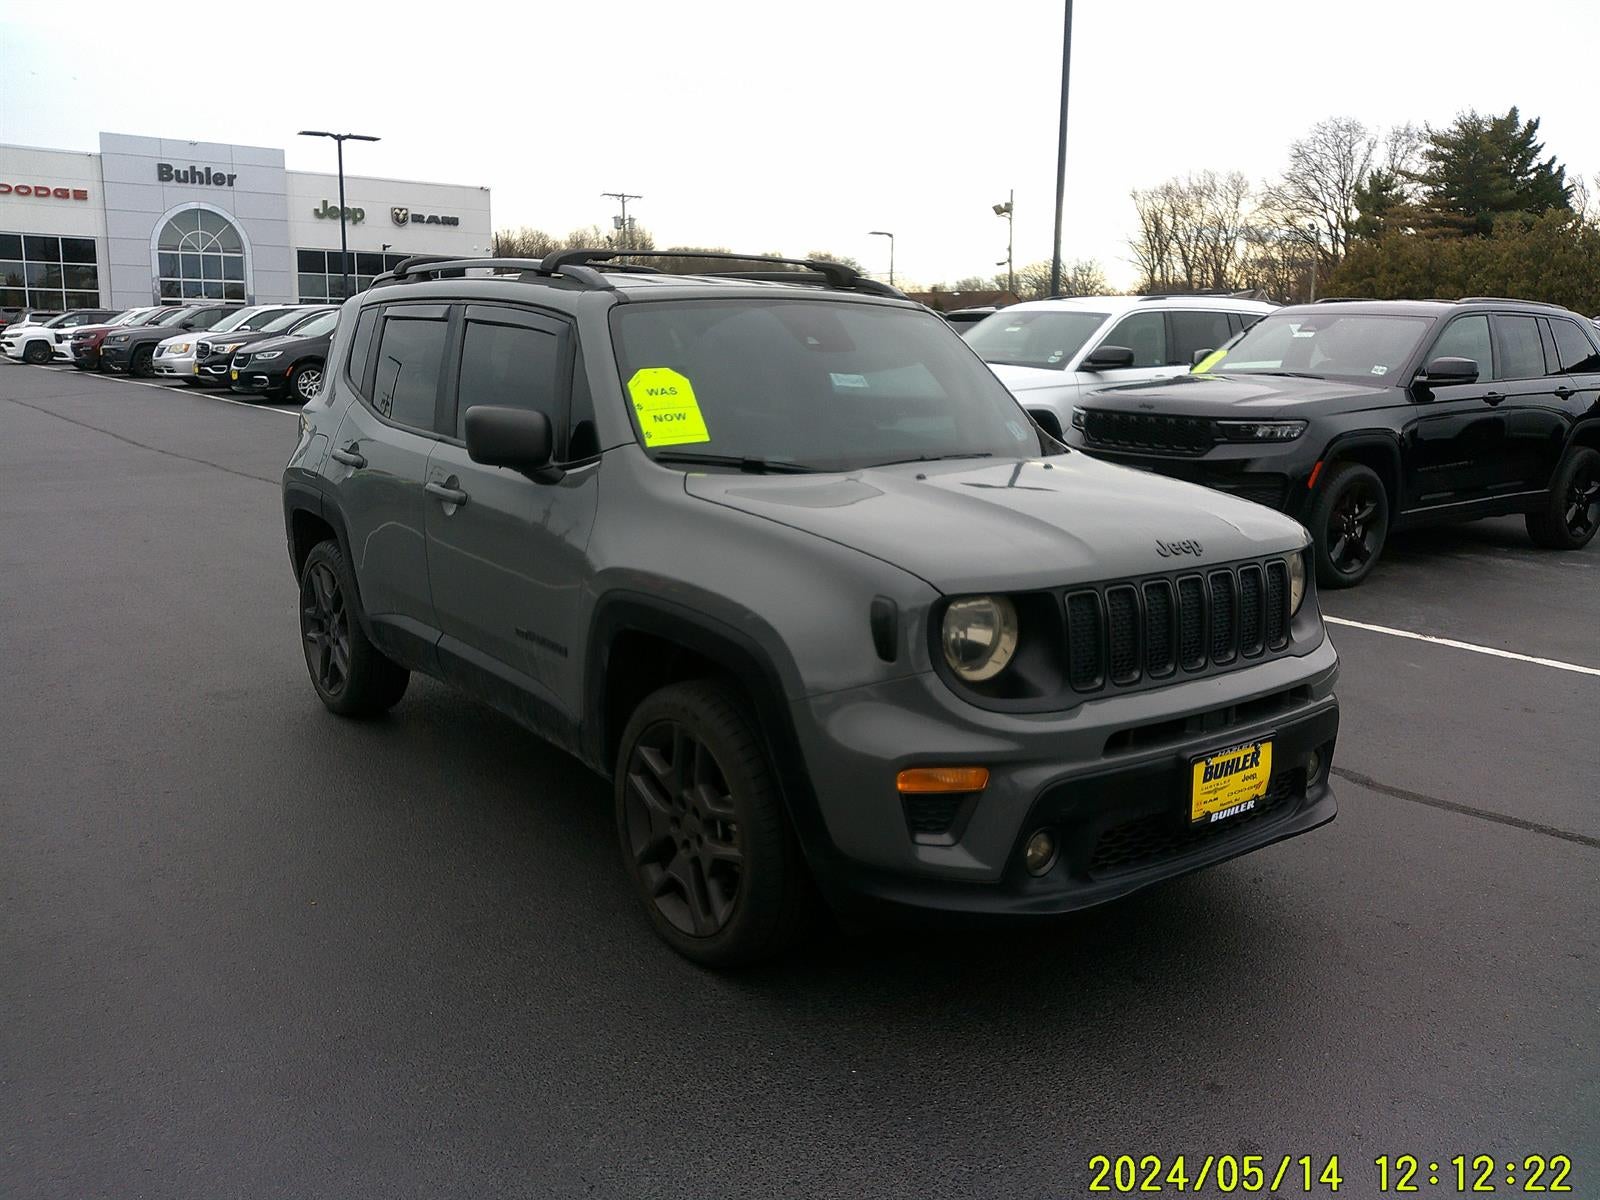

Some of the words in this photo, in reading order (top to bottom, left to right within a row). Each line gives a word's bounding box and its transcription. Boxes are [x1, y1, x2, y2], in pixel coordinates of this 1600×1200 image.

[157, 163, 237, 187] Buhler
[411, 213, 459, 226] RAM
[646, 386, 678, 397] WAS
[653, 412, 687, 423] NOW
[1155, 539, 1203, 558] Jeep
[1202, 751, 1261, 784] BUHLER
[1210, 799, 1255, 823] BUHLER
